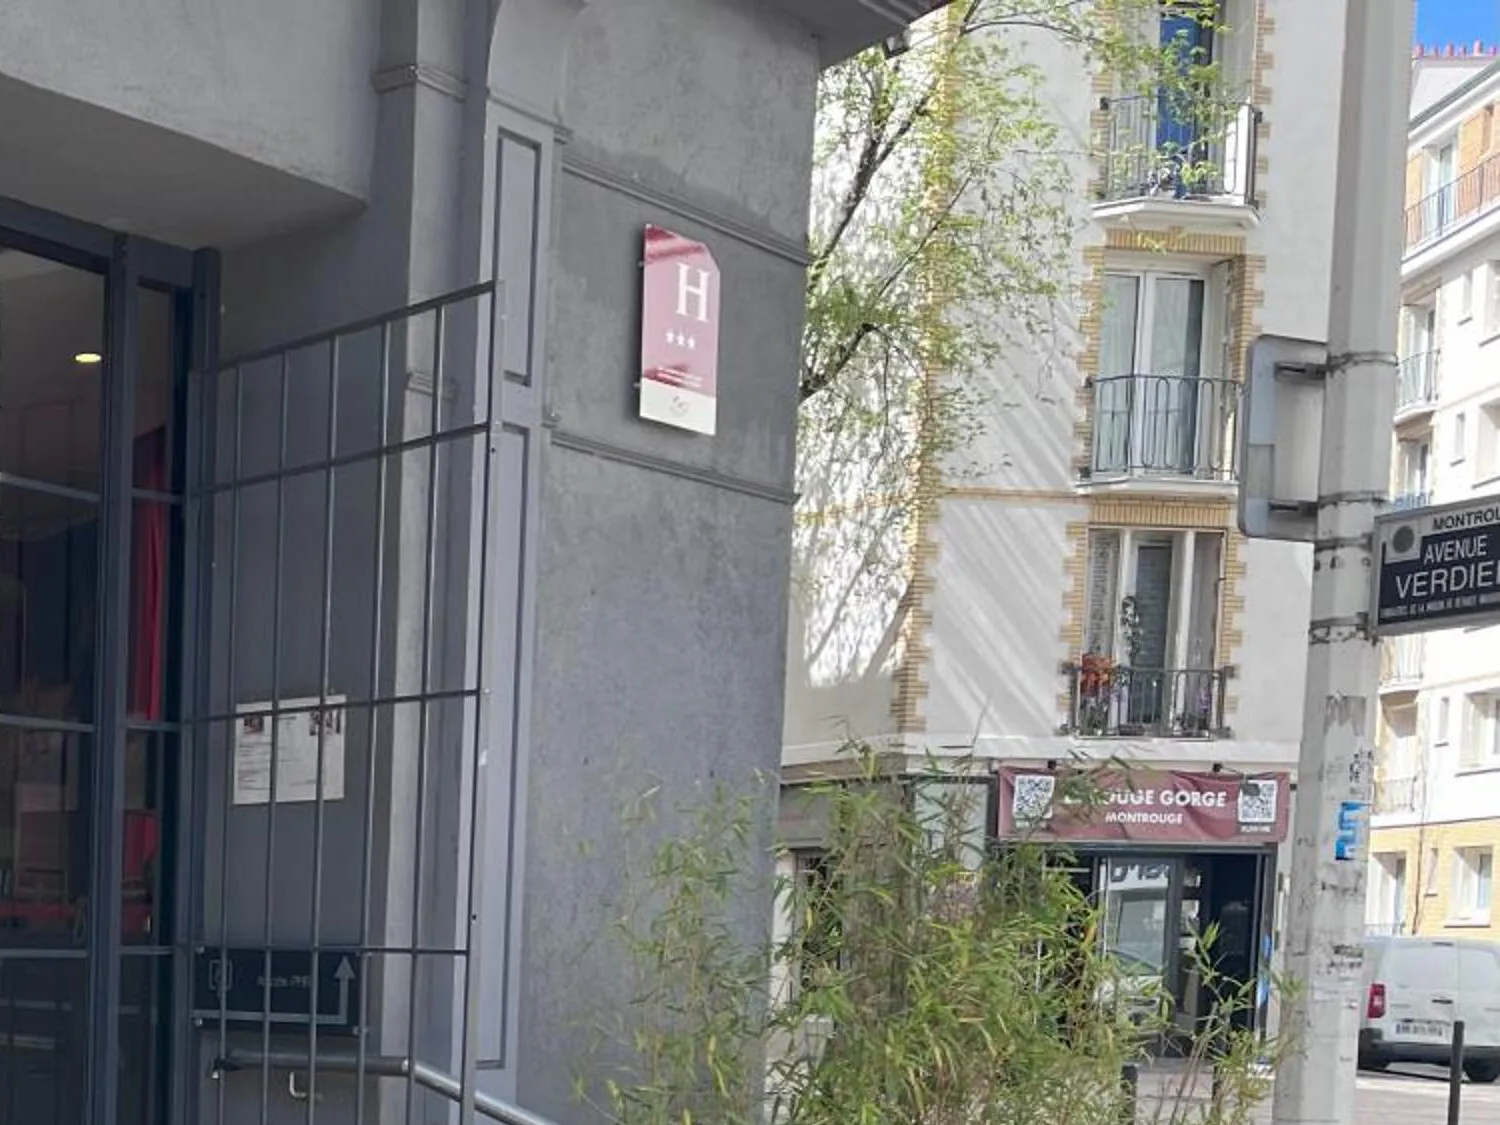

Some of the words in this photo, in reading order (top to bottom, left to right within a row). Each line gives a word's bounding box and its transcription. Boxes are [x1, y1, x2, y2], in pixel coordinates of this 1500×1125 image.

[676, 262, 712, 322] H
[1423, 534, 1488, 565] AVENUE
[1395, 559, 1500, 599] VERDIE
[1160, 789, 1227, 807] GORGE
[1105, 811, 1183, 824] MONTROUGE
